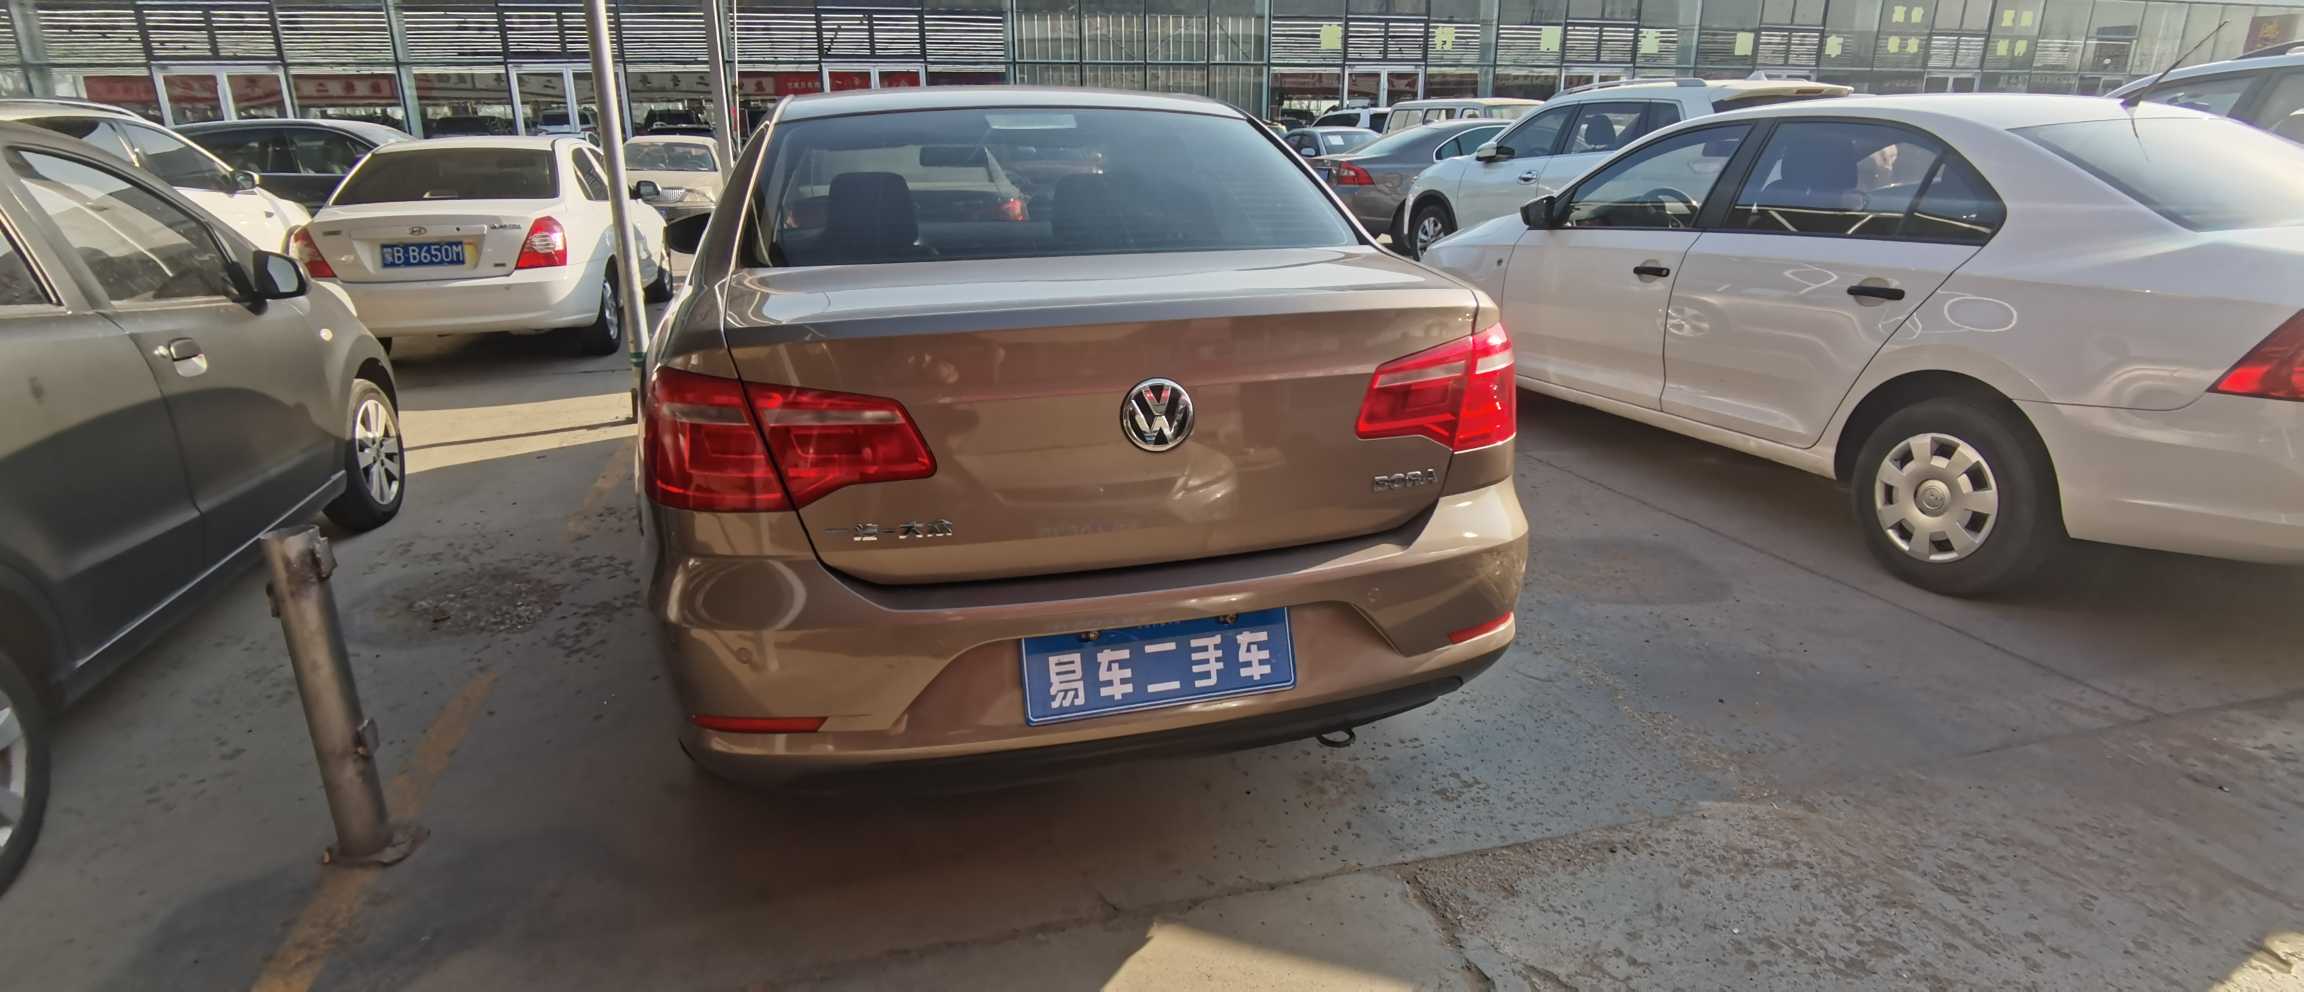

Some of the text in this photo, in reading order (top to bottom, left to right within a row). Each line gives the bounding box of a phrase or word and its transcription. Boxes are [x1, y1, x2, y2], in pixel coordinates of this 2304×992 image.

[1373, 467, 1440, 492] BORA
[1047, 630, 1272, 709] 易车二手车
